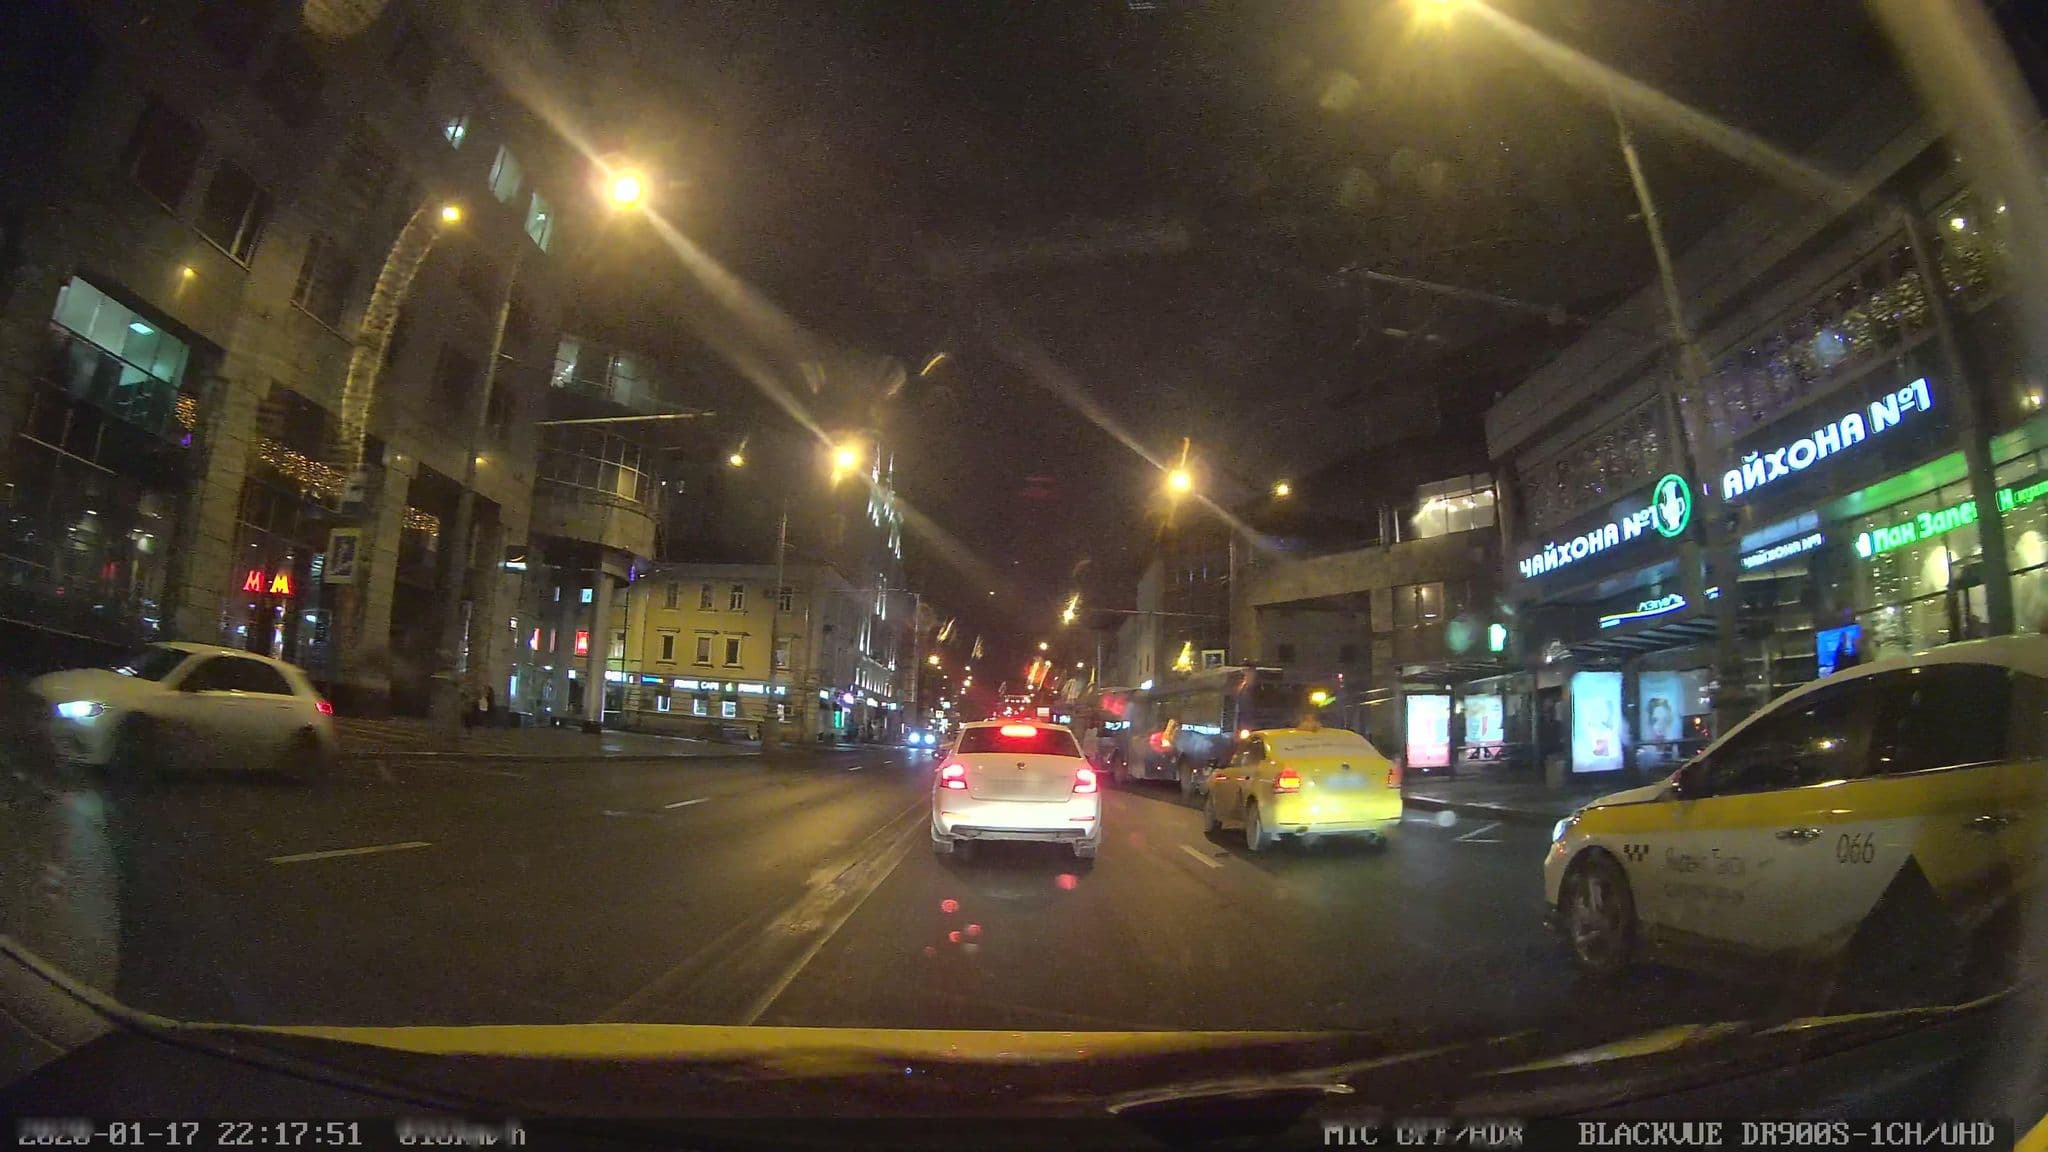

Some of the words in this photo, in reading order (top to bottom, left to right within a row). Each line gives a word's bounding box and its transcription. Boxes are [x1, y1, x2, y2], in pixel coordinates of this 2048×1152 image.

[1704, 412, 1867, 501] АЙХОНА
[1868, 377, 1933, 433] №1
[1519, 523, 1620, 578] ЧАЙХОНА
[1836, 831, 1875, 864] 066
